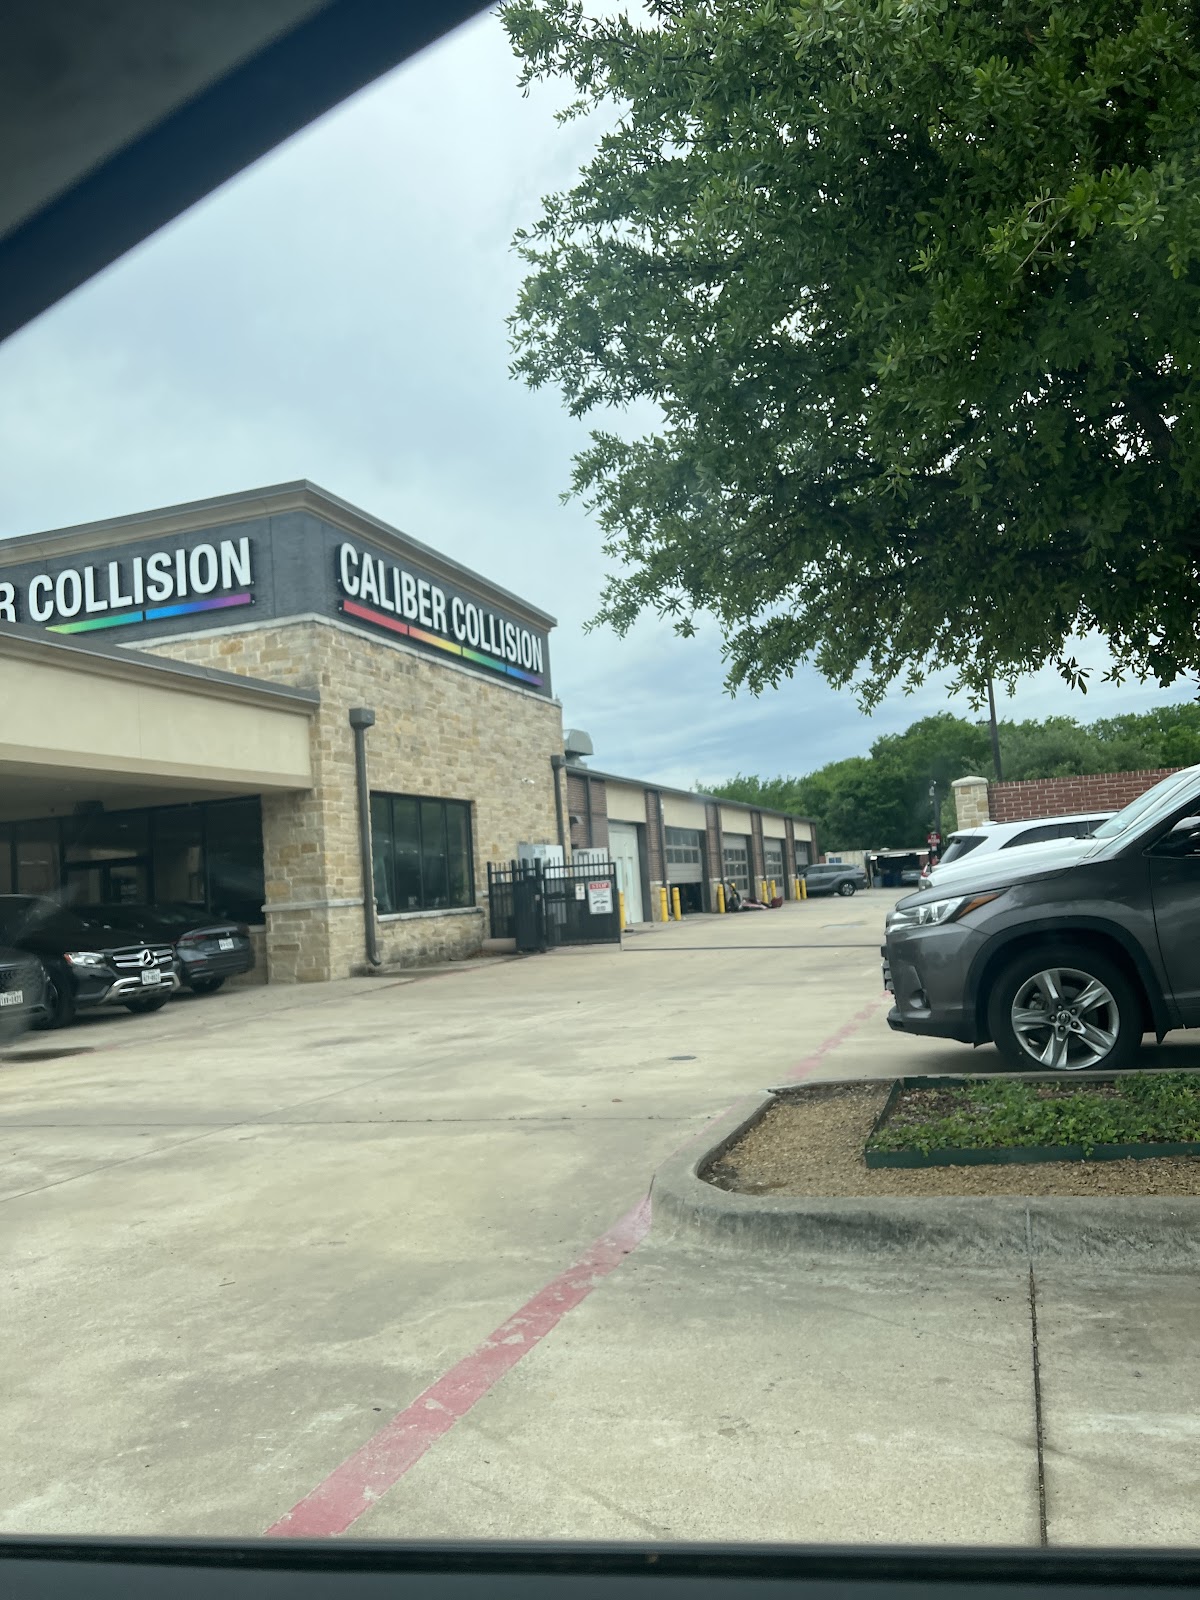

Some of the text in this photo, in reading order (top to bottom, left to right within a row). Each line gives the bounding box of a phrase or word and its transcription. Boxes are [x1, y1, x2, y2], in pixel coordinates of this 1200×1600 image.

[28, 536, 252, 622] COLLISION
[339, 541, 544, 674] CALIBER COLLISION
